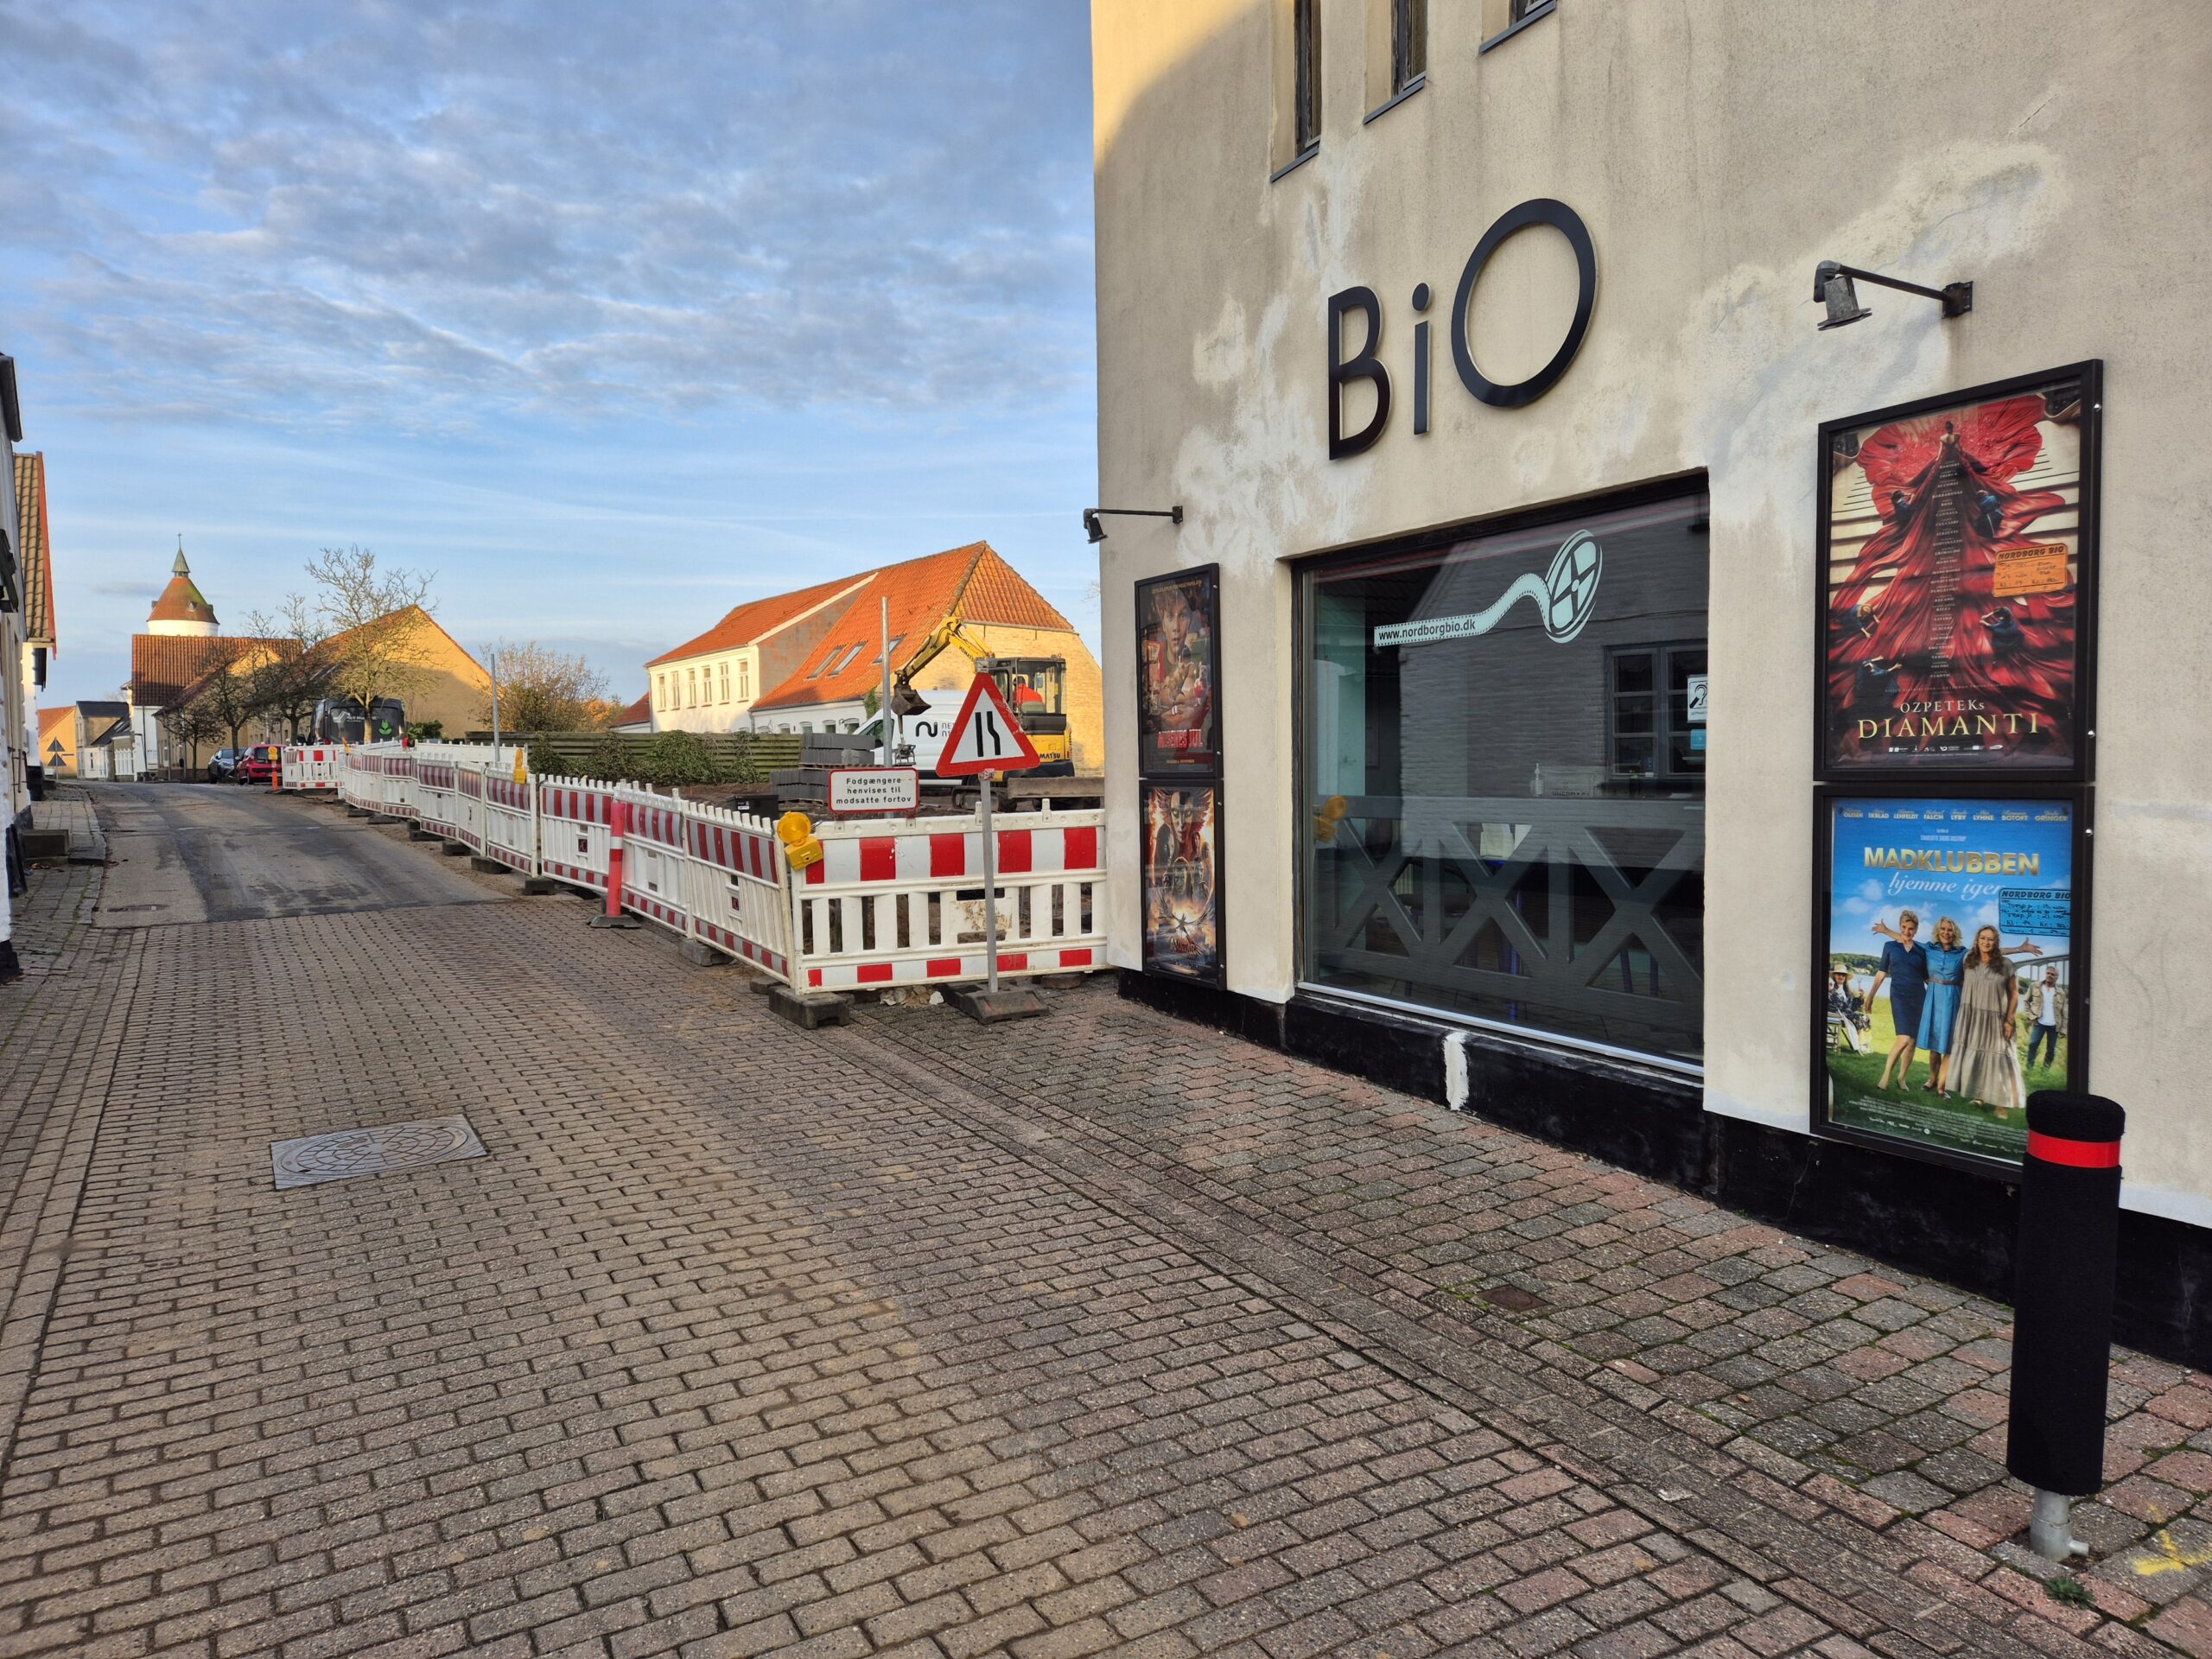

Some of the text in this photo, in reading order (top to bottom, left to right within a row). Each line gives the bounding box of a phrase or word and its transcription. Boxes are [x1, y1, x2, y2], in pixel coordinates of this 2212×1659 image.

[1328, 198, 1597, 461] BiO
[1998, 549, 2045, 560] NORDBORG
[1379, 620, 1476, 640] www.nordborgbio.dk
[1900, 699, 1985, 714] OZPETEKs
[1858, 713, 2038, 739] DIAMANTI
[1864, 846, 2039, 876] MADKLUBBEN
[1888, 871, 1957, 896] hjemme
[2001, 890, 2051, 899] NORDBORG
